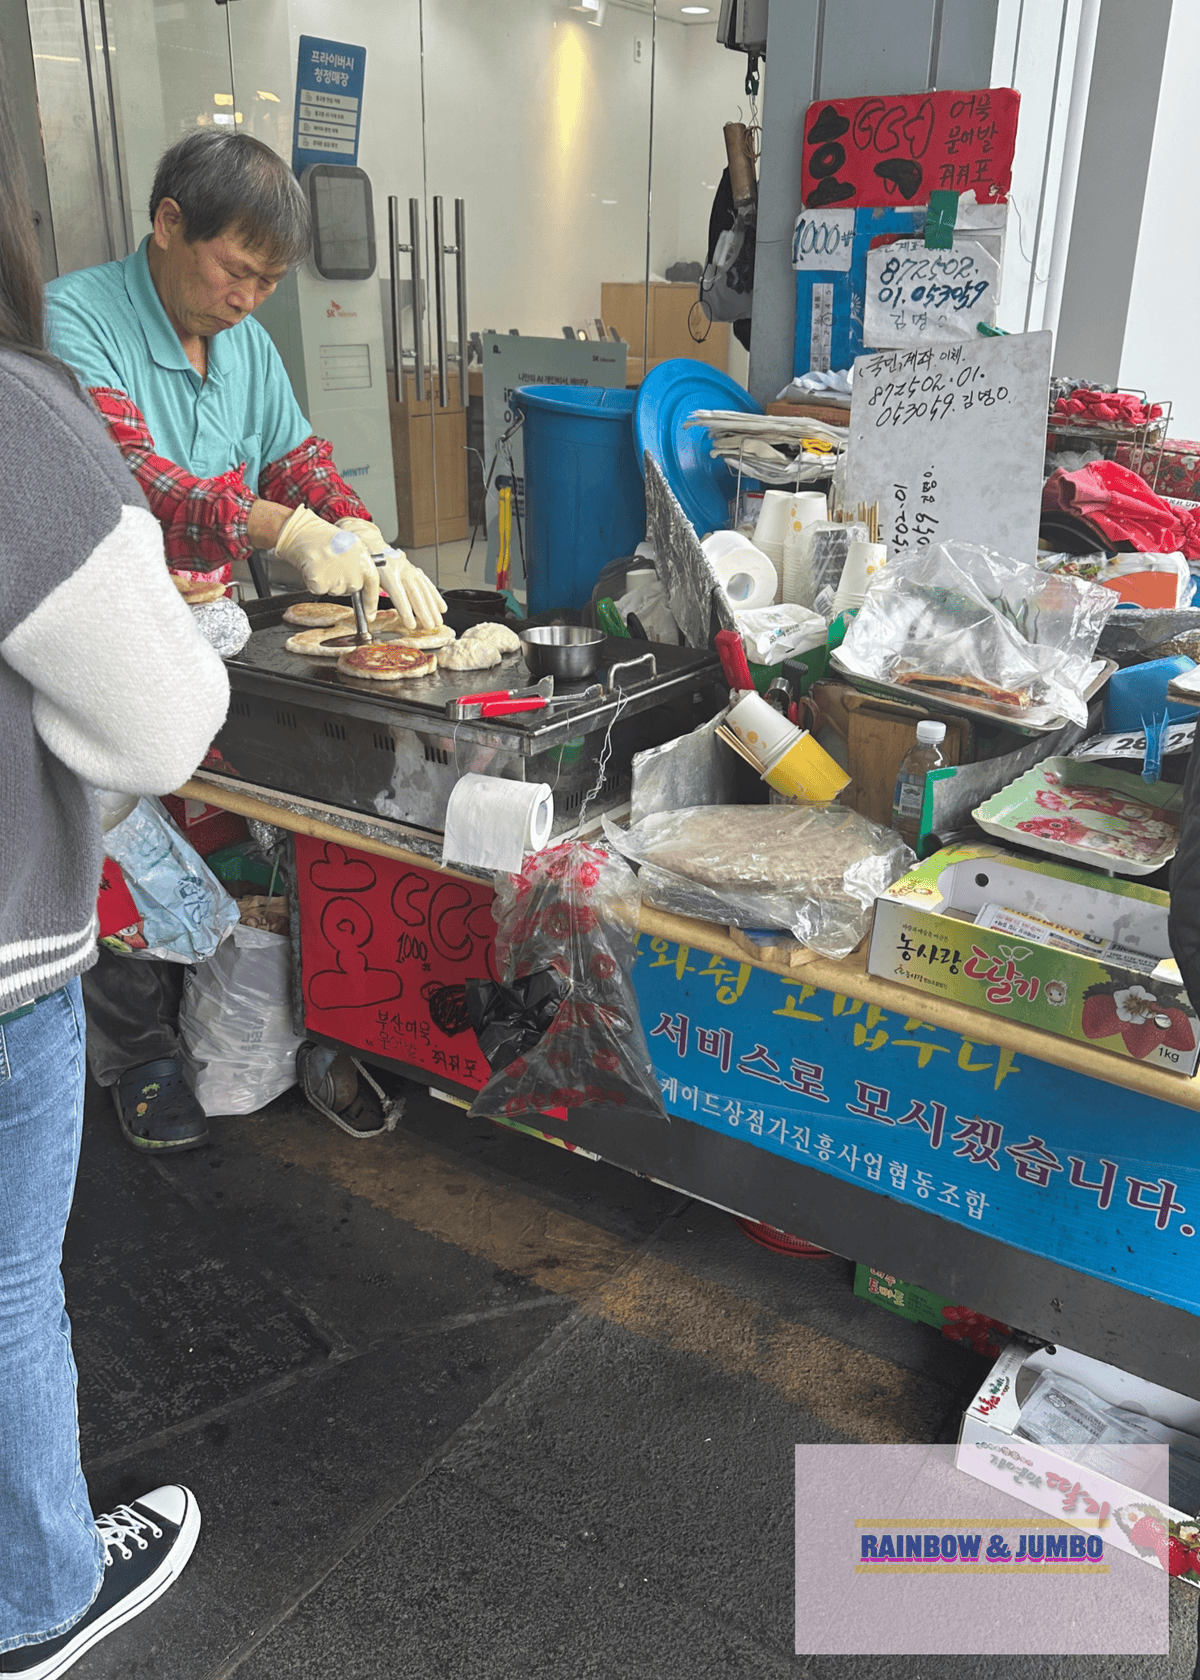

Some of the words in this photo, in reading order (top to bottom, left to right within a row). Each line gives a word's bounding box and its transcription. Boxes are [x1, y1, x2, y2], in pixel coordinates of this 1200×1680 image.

[311, 50, 354, 71] 프라이버시
[314, 67, 349, 87] 청정매장
[949, 94, 992, 122] 어묵
[944, 121, 999, 154] 문어발
[897, 933, 962, 975] 농사랑
[963, 945, 1040, 1004] 딸기
[1158, 1046, 1180, 1063] 1kg
[650, 1012, 830, 1102] 서비스로
[846, 1080, 1195, 1237] 모시겠습니다.
